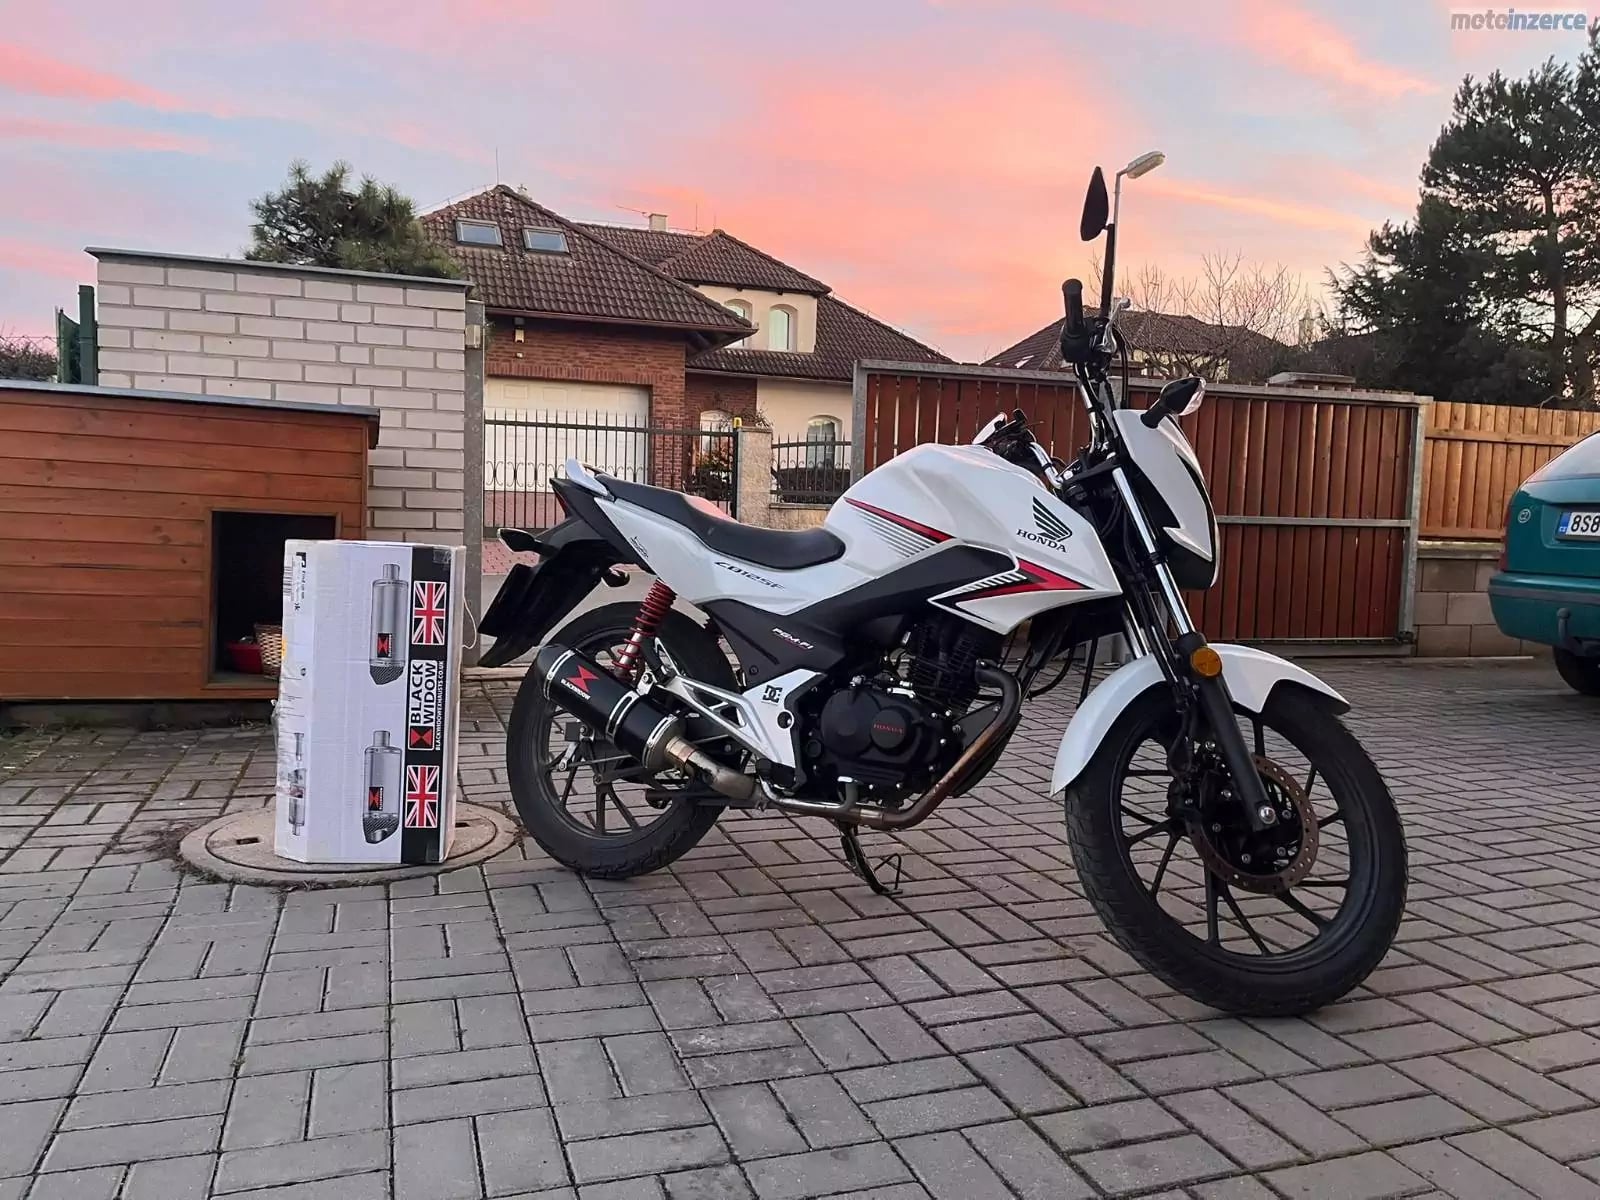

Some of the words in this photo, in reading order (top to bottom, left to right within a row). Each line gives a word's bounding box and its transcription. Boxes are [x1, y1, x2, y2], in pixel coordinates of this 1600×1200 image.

[1016, 529, 1067, 553] HONDA
[1571, 514, 1600, 533] 8S8
[410, 663, 424, 724] BLACK
[423, 662, 436, 724] WIDOW
